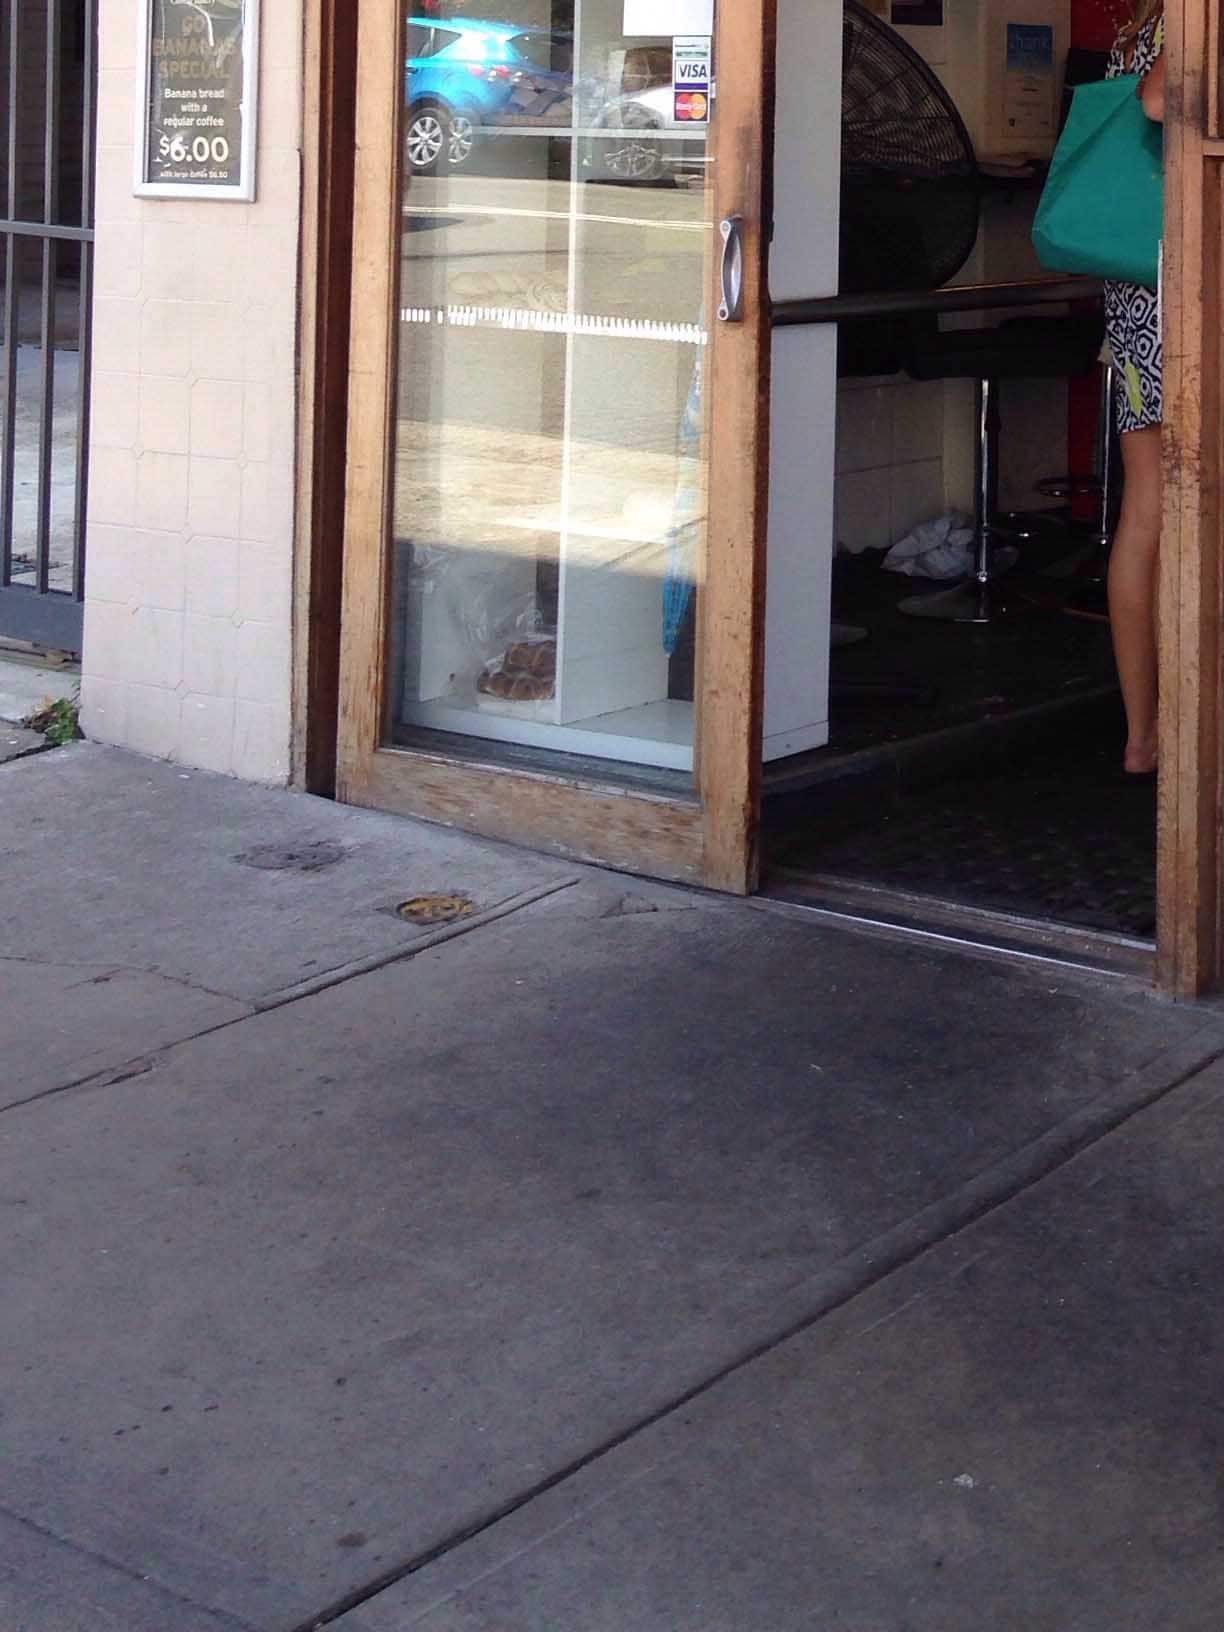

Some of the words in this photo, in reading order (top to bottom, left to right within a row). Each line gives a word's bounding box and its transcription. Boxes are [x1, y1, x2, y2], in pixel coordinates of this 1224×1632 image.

[159, 60, 231, 80] SPECIAL
[679, 64, 708, 78] VISA
[164, 88, 197, 99] Banana
[199, 88, 224, 99] bread
[180, 102, 201, 113] with
[201, 104, 208, 113] a
[163, 116, 195, 130] regular
[196, 115, 224, 127] coffee
[159, 135, 229, 163] $6.00
